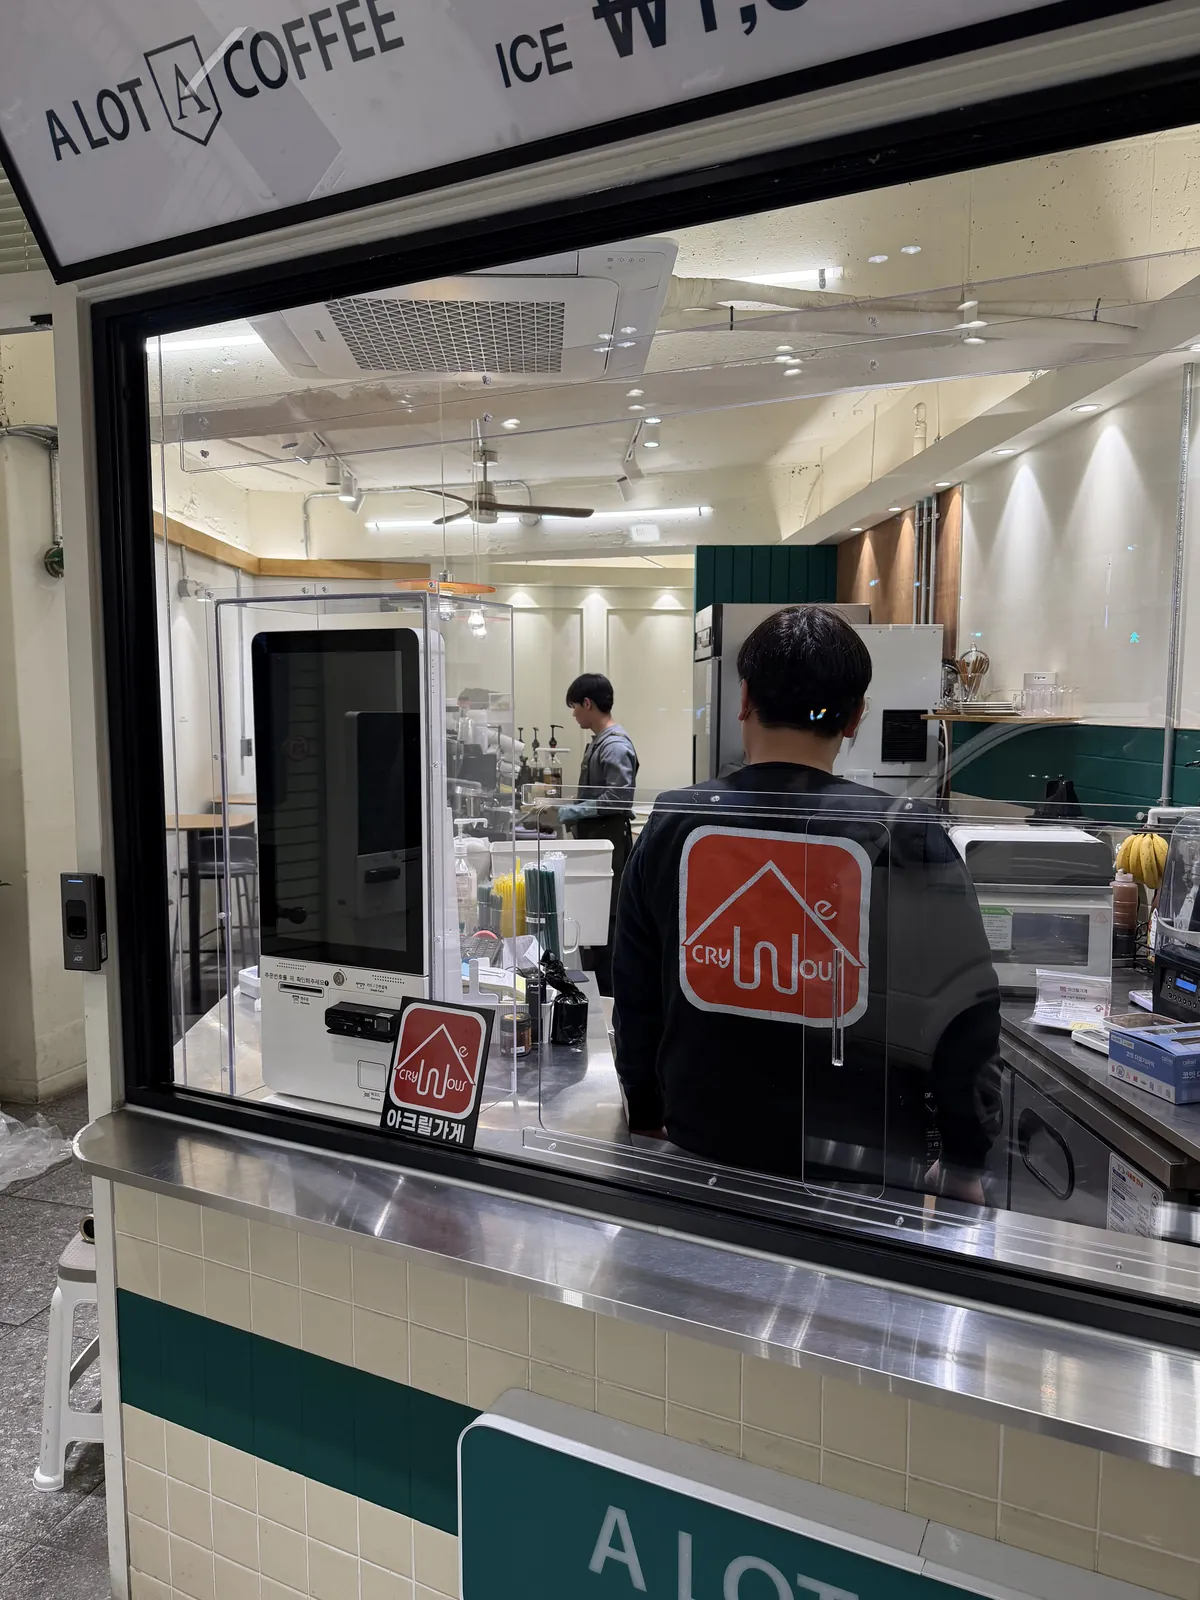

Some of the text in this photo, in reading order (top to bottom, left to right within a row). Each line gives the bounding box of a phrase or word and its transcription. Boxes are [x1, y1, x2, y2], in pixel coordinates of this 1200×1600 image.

[223, 0, 405, 99] COFFEE
[495, 23, 573, 88] ICE
[386, 1109, 466, 1144] 아크릴가게
[588, 1505, 647, 1592] A
